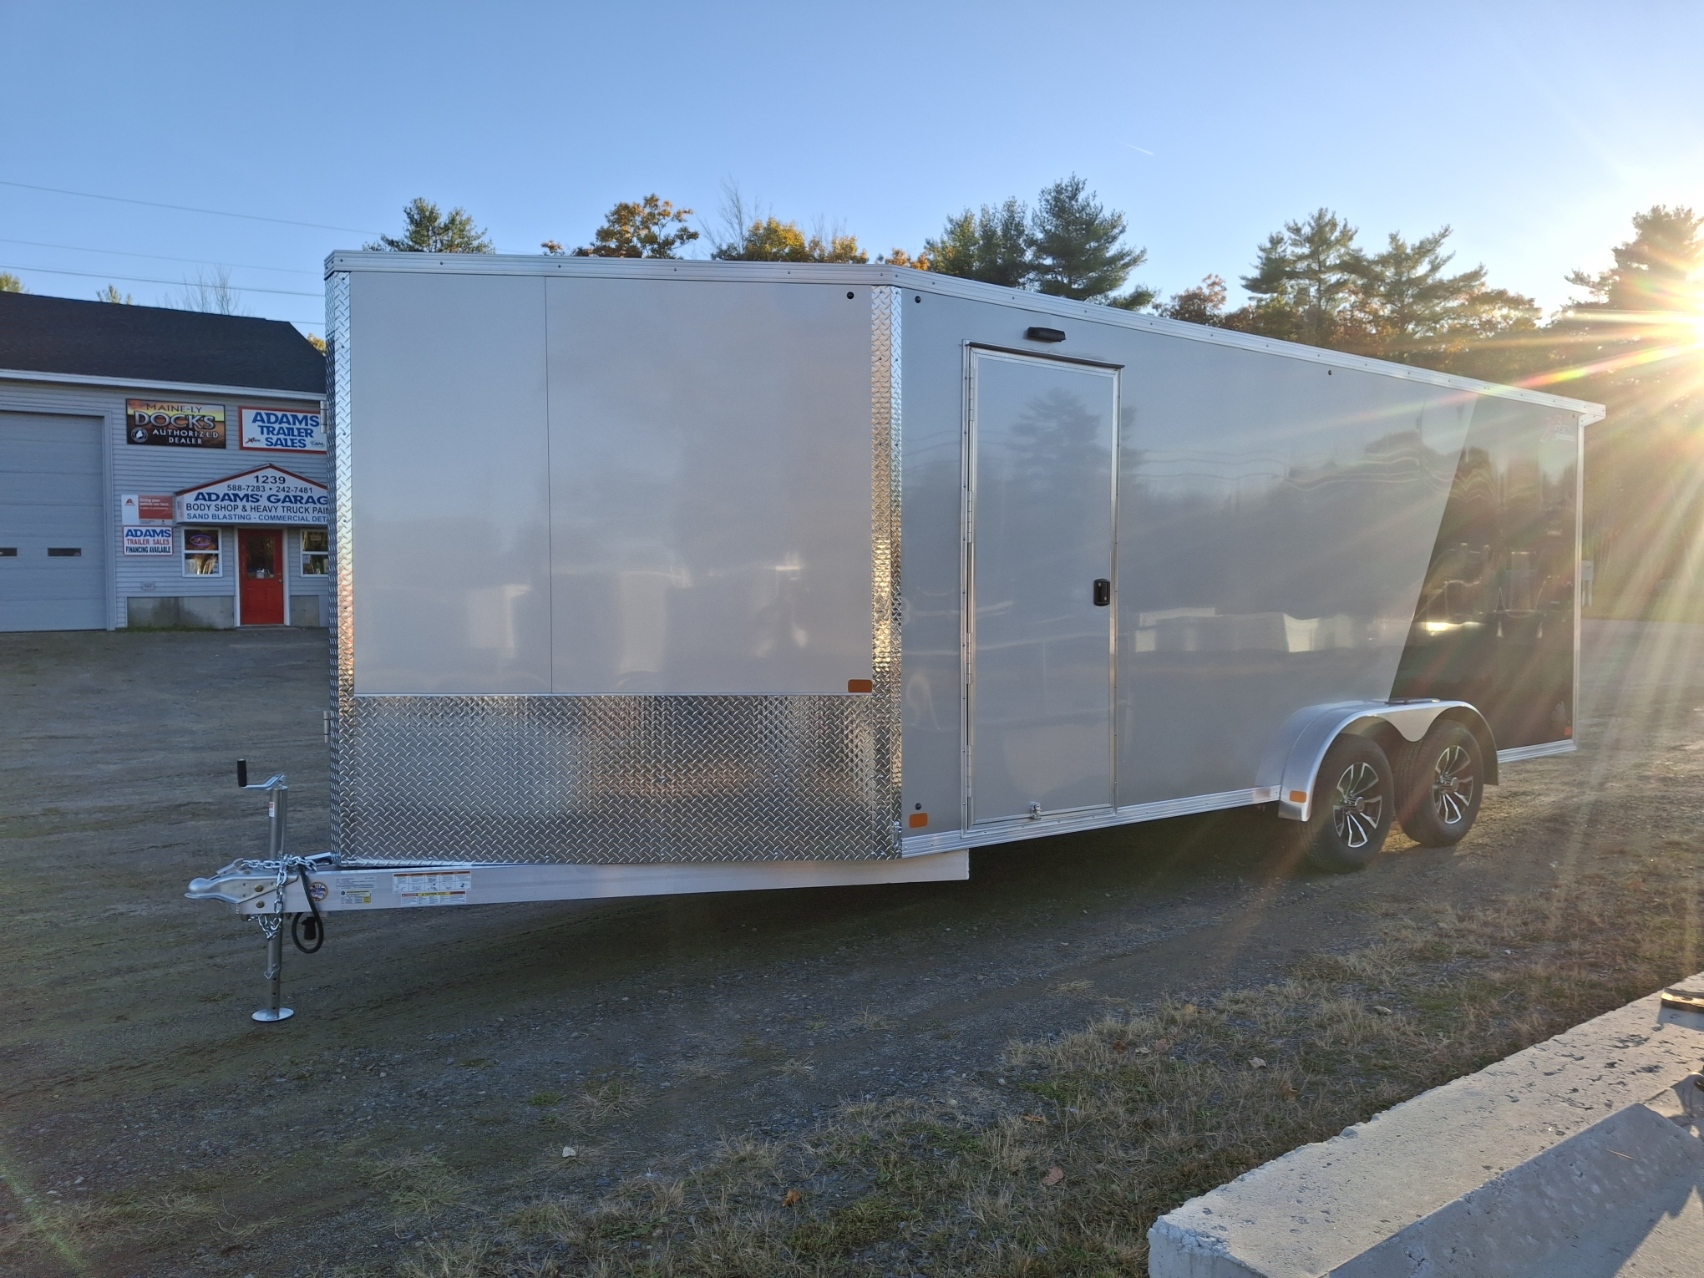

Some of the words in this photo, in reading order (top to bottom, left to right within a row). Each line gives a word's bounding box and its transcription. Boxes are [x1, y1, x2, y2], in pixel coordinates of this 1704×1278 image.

[146, 403, 203, 413] MAINE-LY
[133, 410, 215, 430] DOCKS
[252, 411, 320, 427] ADAMS
[152, 429, 219, 438] AUTHORIZED
[257, 425, 314, 438] TRAILER
[168, 436, 203, 445] DEALER
[265, 437, 307, 448] SALES
[253, 475, 286, 485] 1239
[227, 484, 266, 493] 588-7283
[275, 486, 313, 494] 242-7481
[186, 503, 211, 512] BODY
[214, 504, 240, 512] SHOP
[241, 505, 248, 513] &
[250, 505, 279, 514] HEAVY
[281, 505, 310, 514] TRUCK
[211, 513, 252, 521] BLASTING
[258, 514, 311, 522] COMMERCIAL
[312, 515, 328, 523] DET
[125, 528, 171, 538] ADAMS
[152, 538, 170, 546] SALES
[149, 546, 171, 554] AVAILABLE
